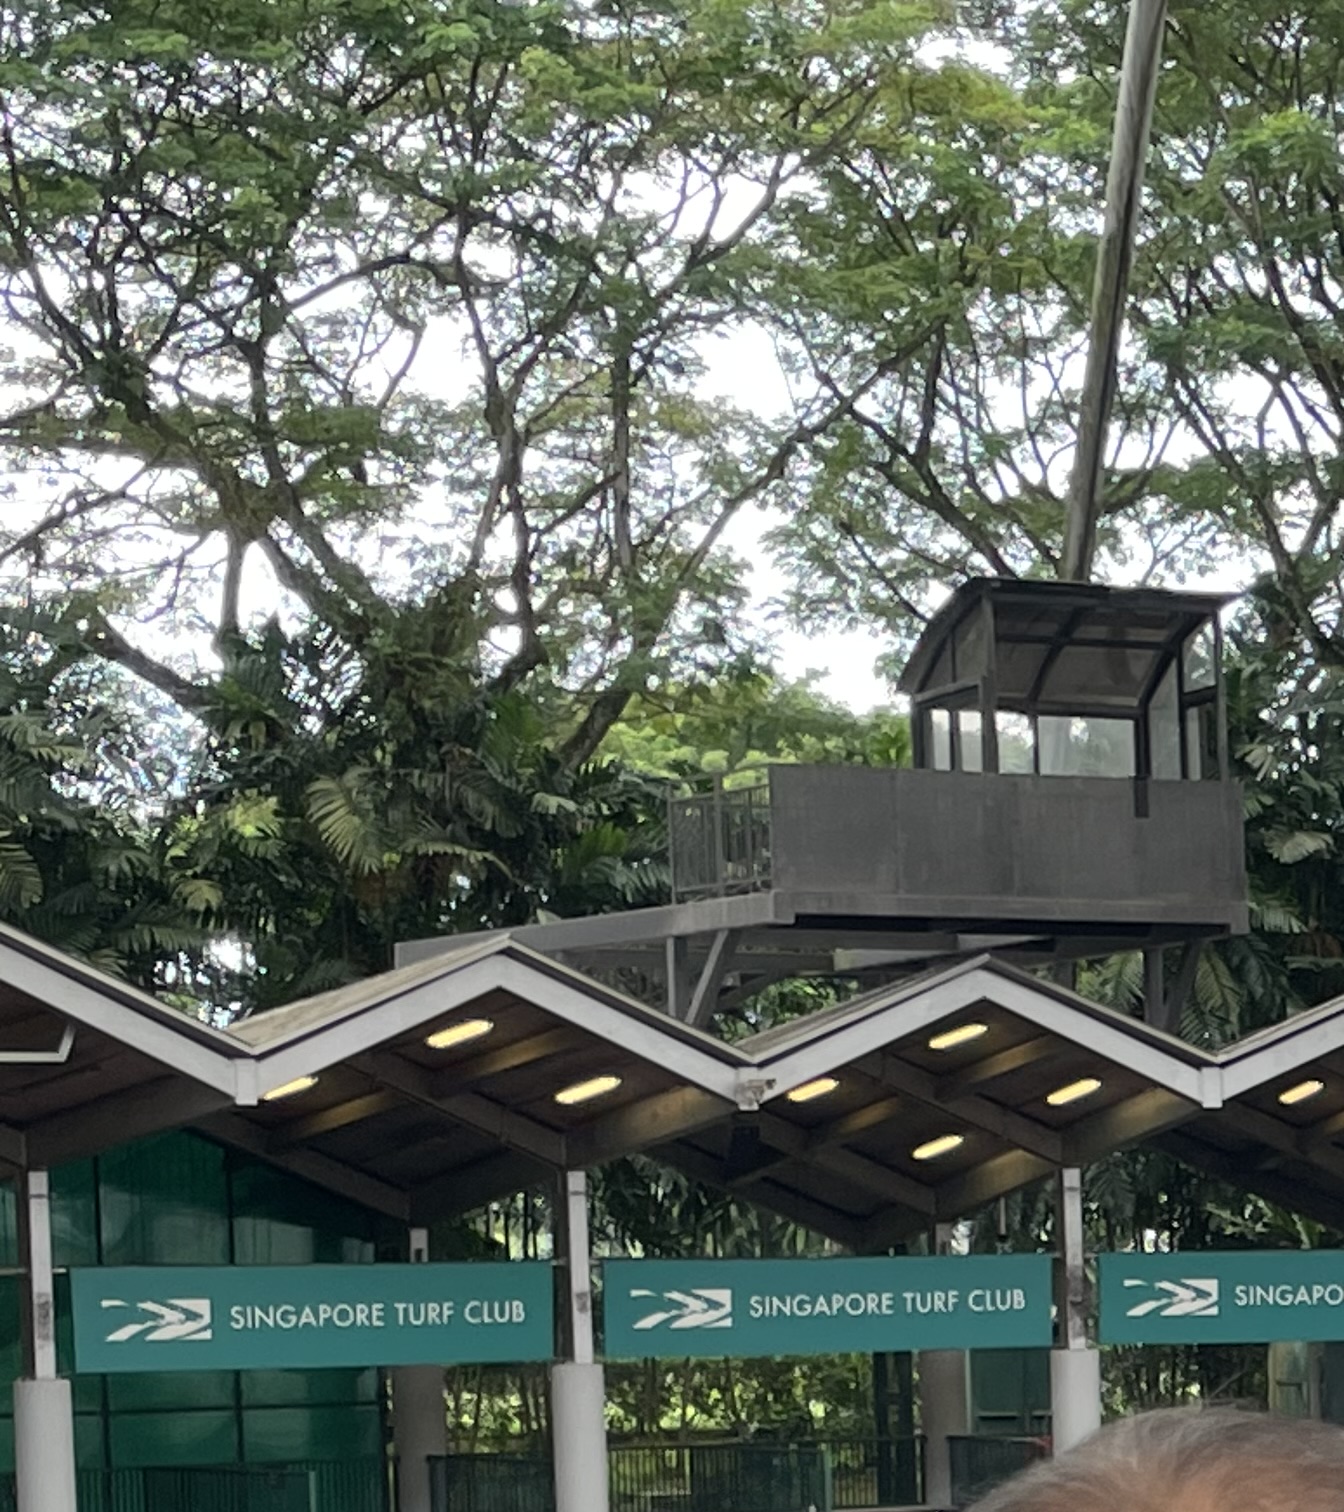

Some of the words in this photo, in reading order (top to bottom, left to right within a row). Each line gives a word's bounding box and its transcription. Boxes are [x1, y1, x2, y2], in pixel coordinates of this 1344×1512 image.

[229, 1301, 386, 1331] SINGAPORE
[392, 1300, 455, 1327] TURF
[463, 1298, 526, 1325] CLUB
[748, 1291, 895, 1319] SINGAPORE
[901, 1289, 960, 1314] TURF
[966, 1287, 1027, 1313] CLUB
